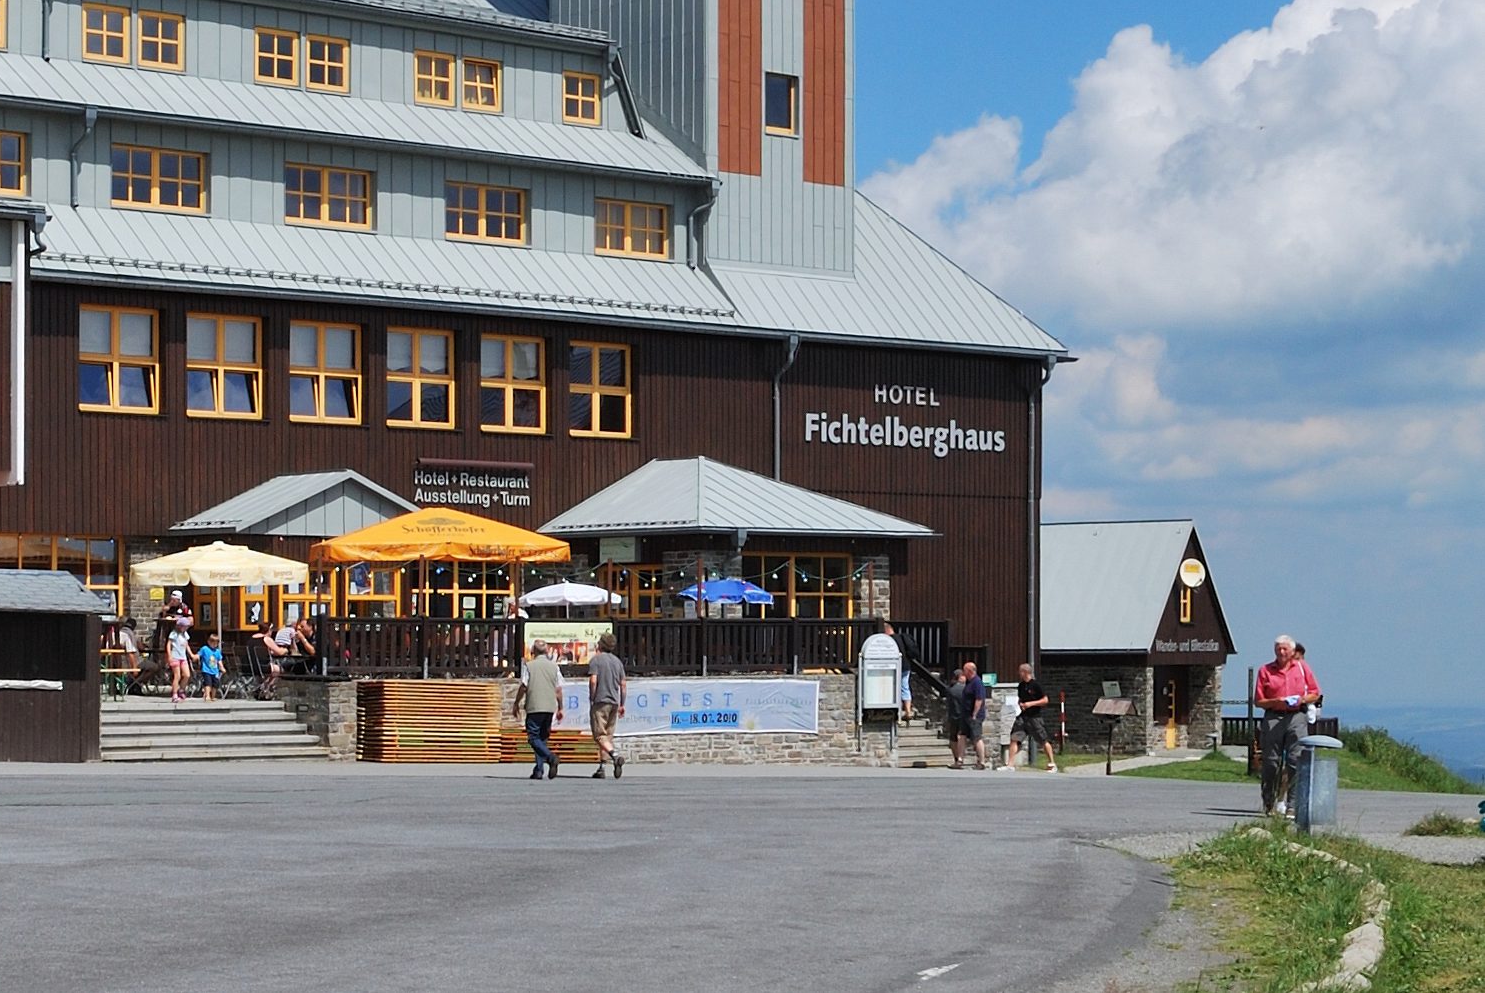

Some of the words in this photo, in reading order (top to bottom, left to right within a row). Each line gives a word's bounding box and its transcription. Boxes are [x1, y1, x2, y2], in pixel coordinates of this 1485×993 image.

[874, 384, 940, 407] HOTEL
[804, 412, 1006, 458] Fichtelberghaus
[414, 470, 449, 486] Hotel
[460, 472, 530, 489] Restaurant
[414, 488, 490, 507] Ausstellung
[500, 491, 531, 506] Turm
[568, 692, 733, 710] BGFEST
[716, 712, 737, 723] 2010
